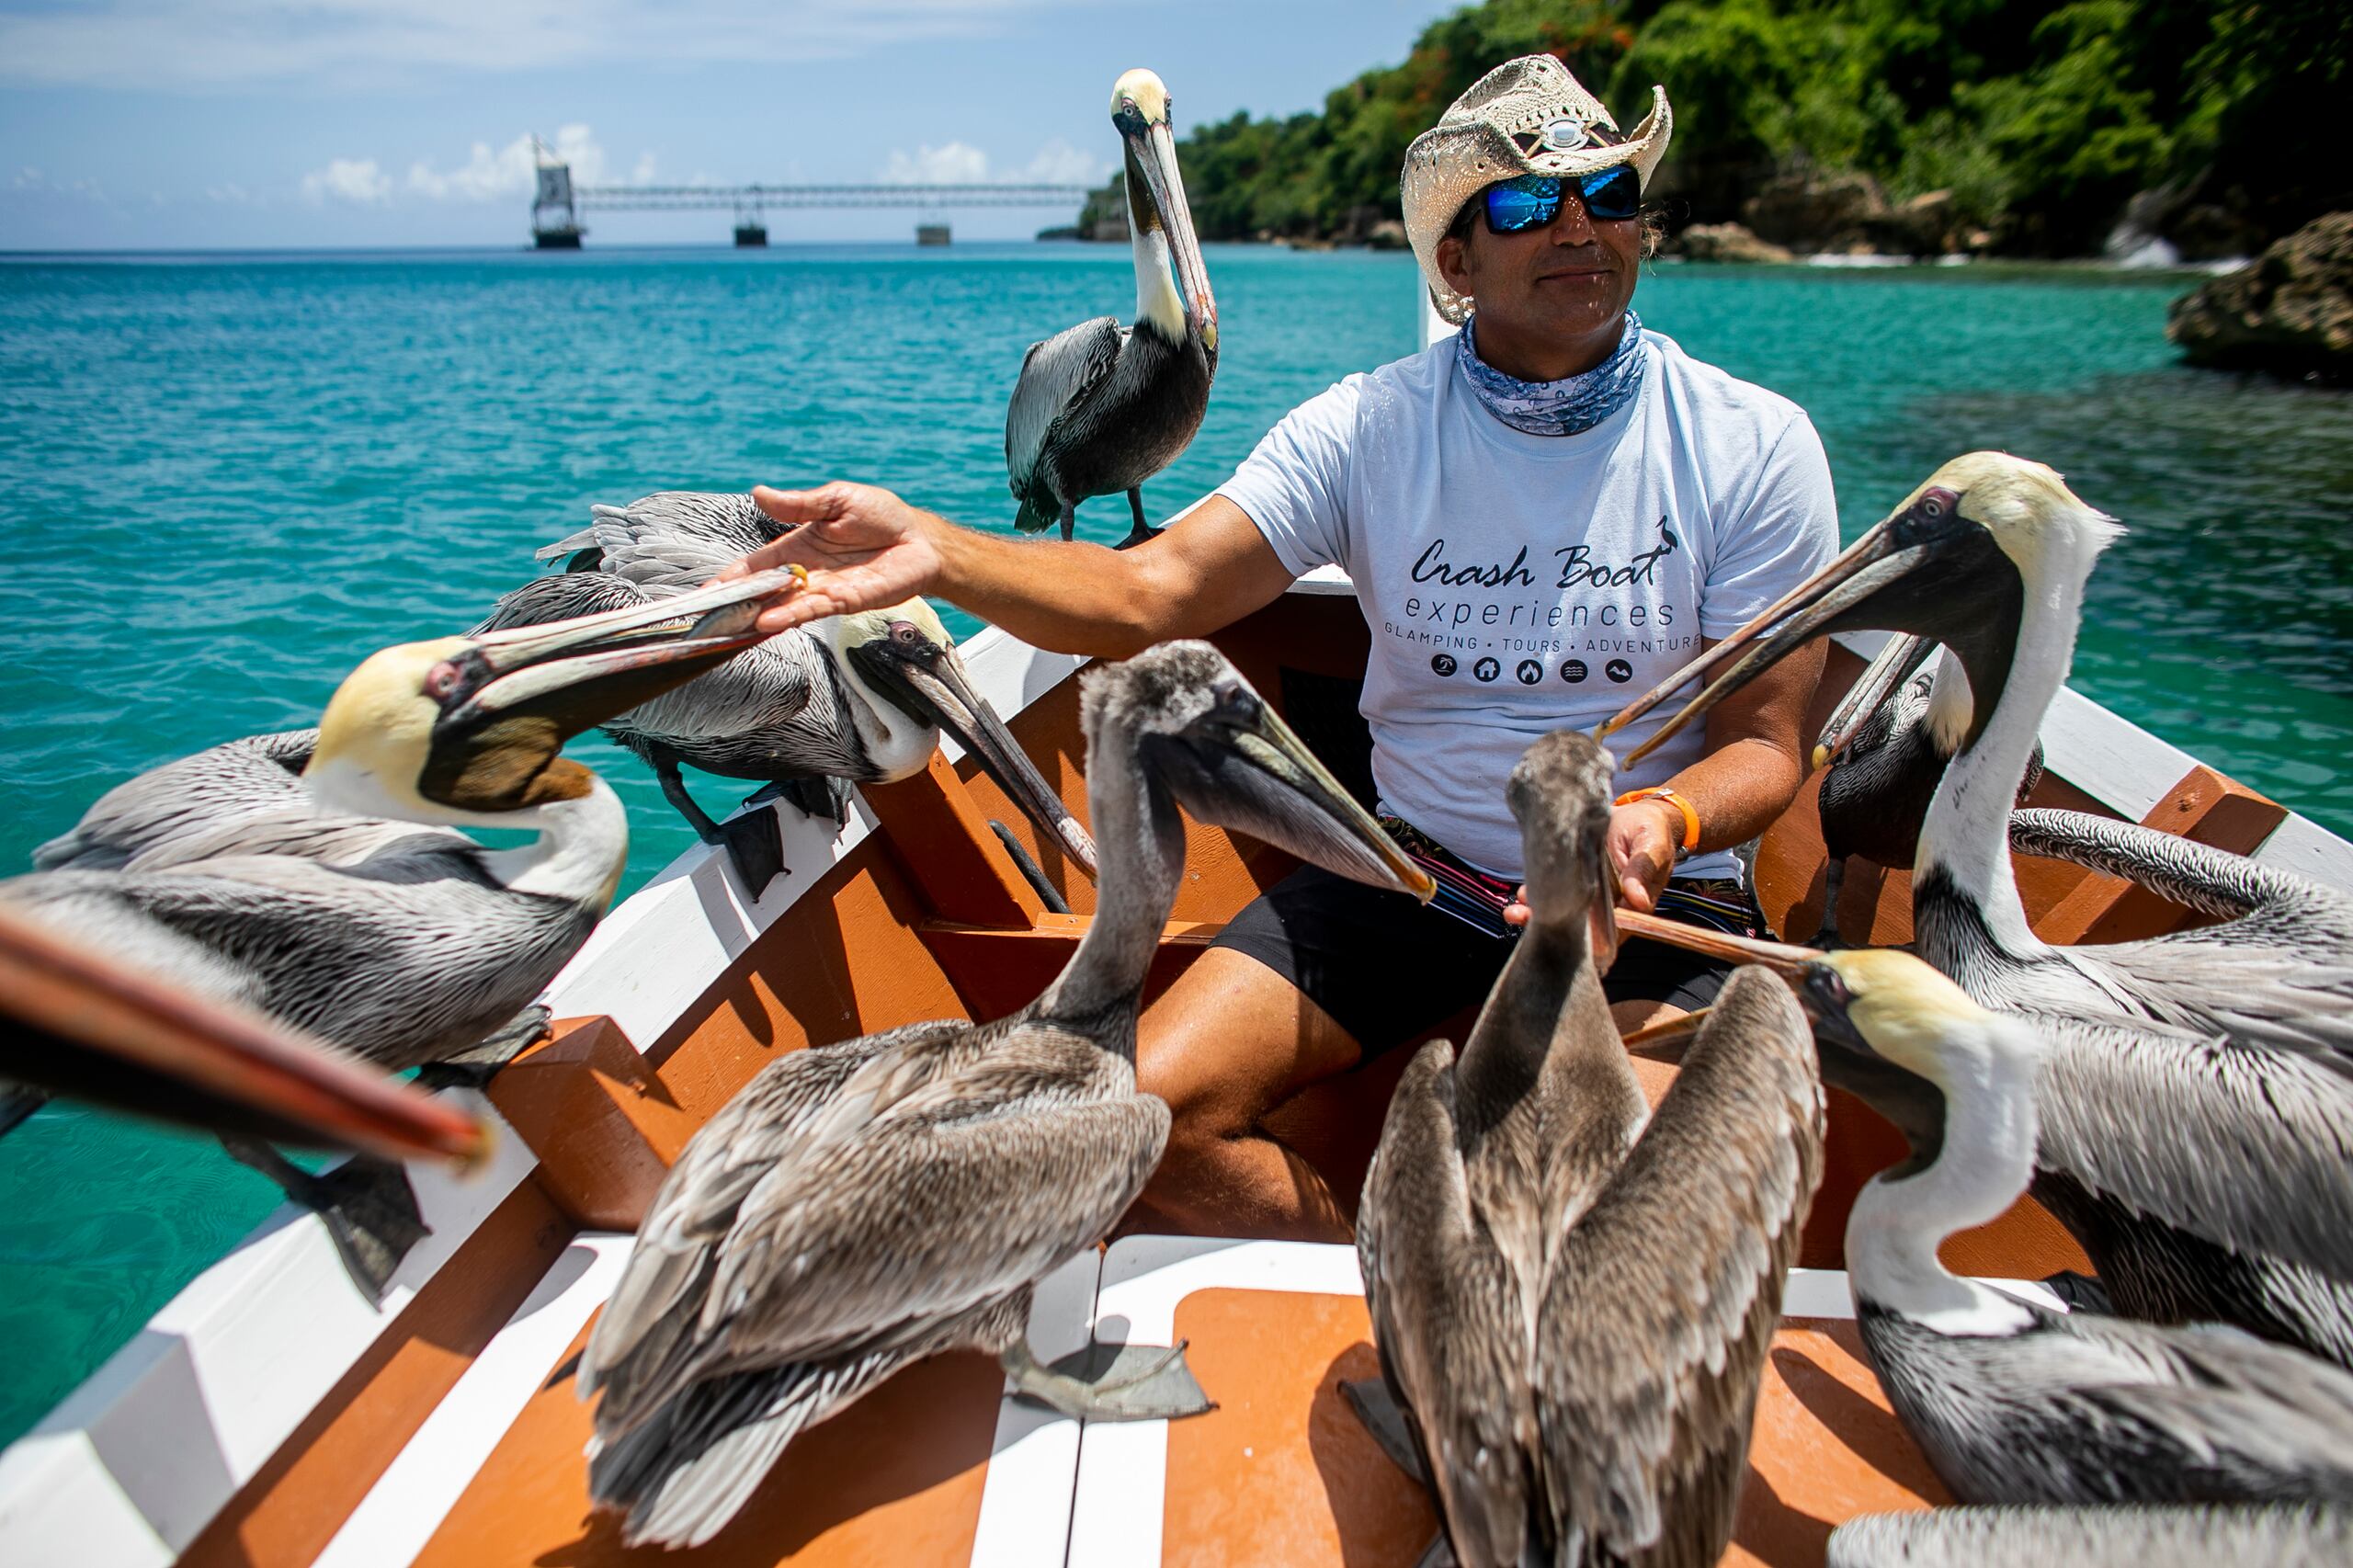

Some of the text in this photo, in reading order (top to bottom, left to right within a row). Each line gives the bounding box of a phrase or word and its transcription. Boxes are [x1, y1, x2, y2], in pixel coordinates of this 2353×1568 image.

[1411, 539, 1671, 589] Crash Boat
[1405, 597, 1675, 630] experiences
[1384, 622, 1478, 649] GLAMPING
[1502, 637, 1561, 653] TOURS
